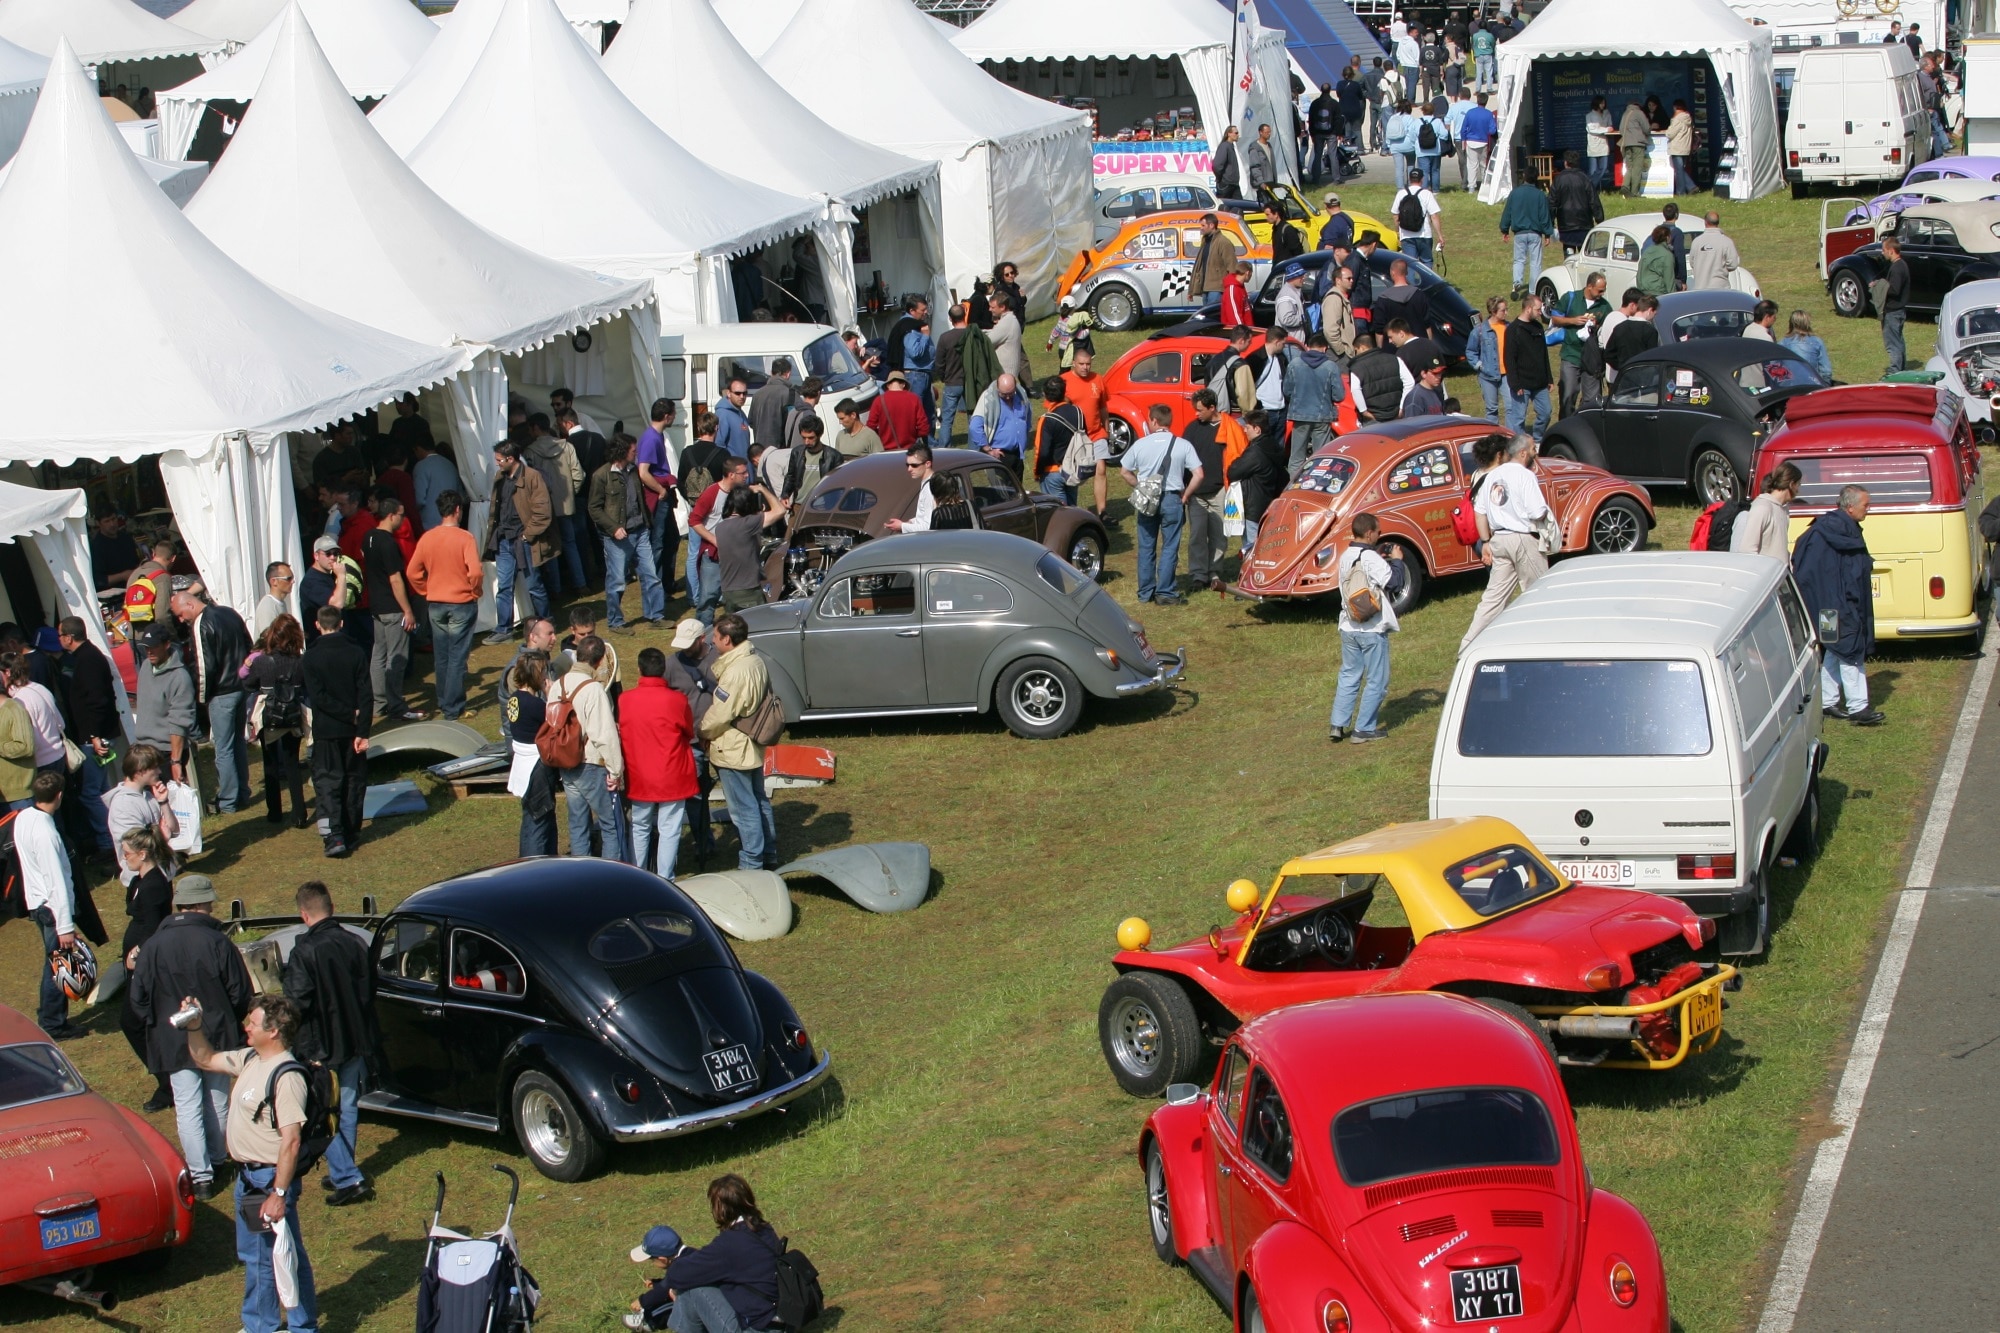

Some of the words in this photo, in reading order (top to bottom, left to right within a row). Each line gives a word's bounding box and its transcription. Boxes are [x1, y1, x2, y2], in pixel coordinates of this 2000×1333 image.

[1552, 88, 1585, 99] Simplifier
[1588, 88, 1593, 96] la
[1595, 87, 1606, 95] Vie
[1608, 87, 1617, 95] du
[1619, 86, 1640, 94] Client
[1093, 154, 1167, 174] SUPER
[1173, 154, 1213, 172] VW
[1140, 221, 1163, 231] CAR
[1141, 232, 1163, 246] 304
[1085, 276, 1099, 294] CHV
[1424, 508, 1446, 523] 666
[1481, 665, 1506, 673] Castrol
[1667, 662, 1694, 672] Castrol
[1592, 865, 1617, 879] 403
[1623, 865, 1632, 878] B
[711, 1048, 744, 1069] 3184
[714, 1070, 732, 1088] XY
[736, 1064, 752, 1081] 17
[46, 1226, 69, 1244] 953
[72, 1220, 95, 1238] WZB
[1463, 1268, 1509, 1292] 3187
[1460, 1296, 1482, 1319] XY
[1493, 1292, 1514, 1315] 17
